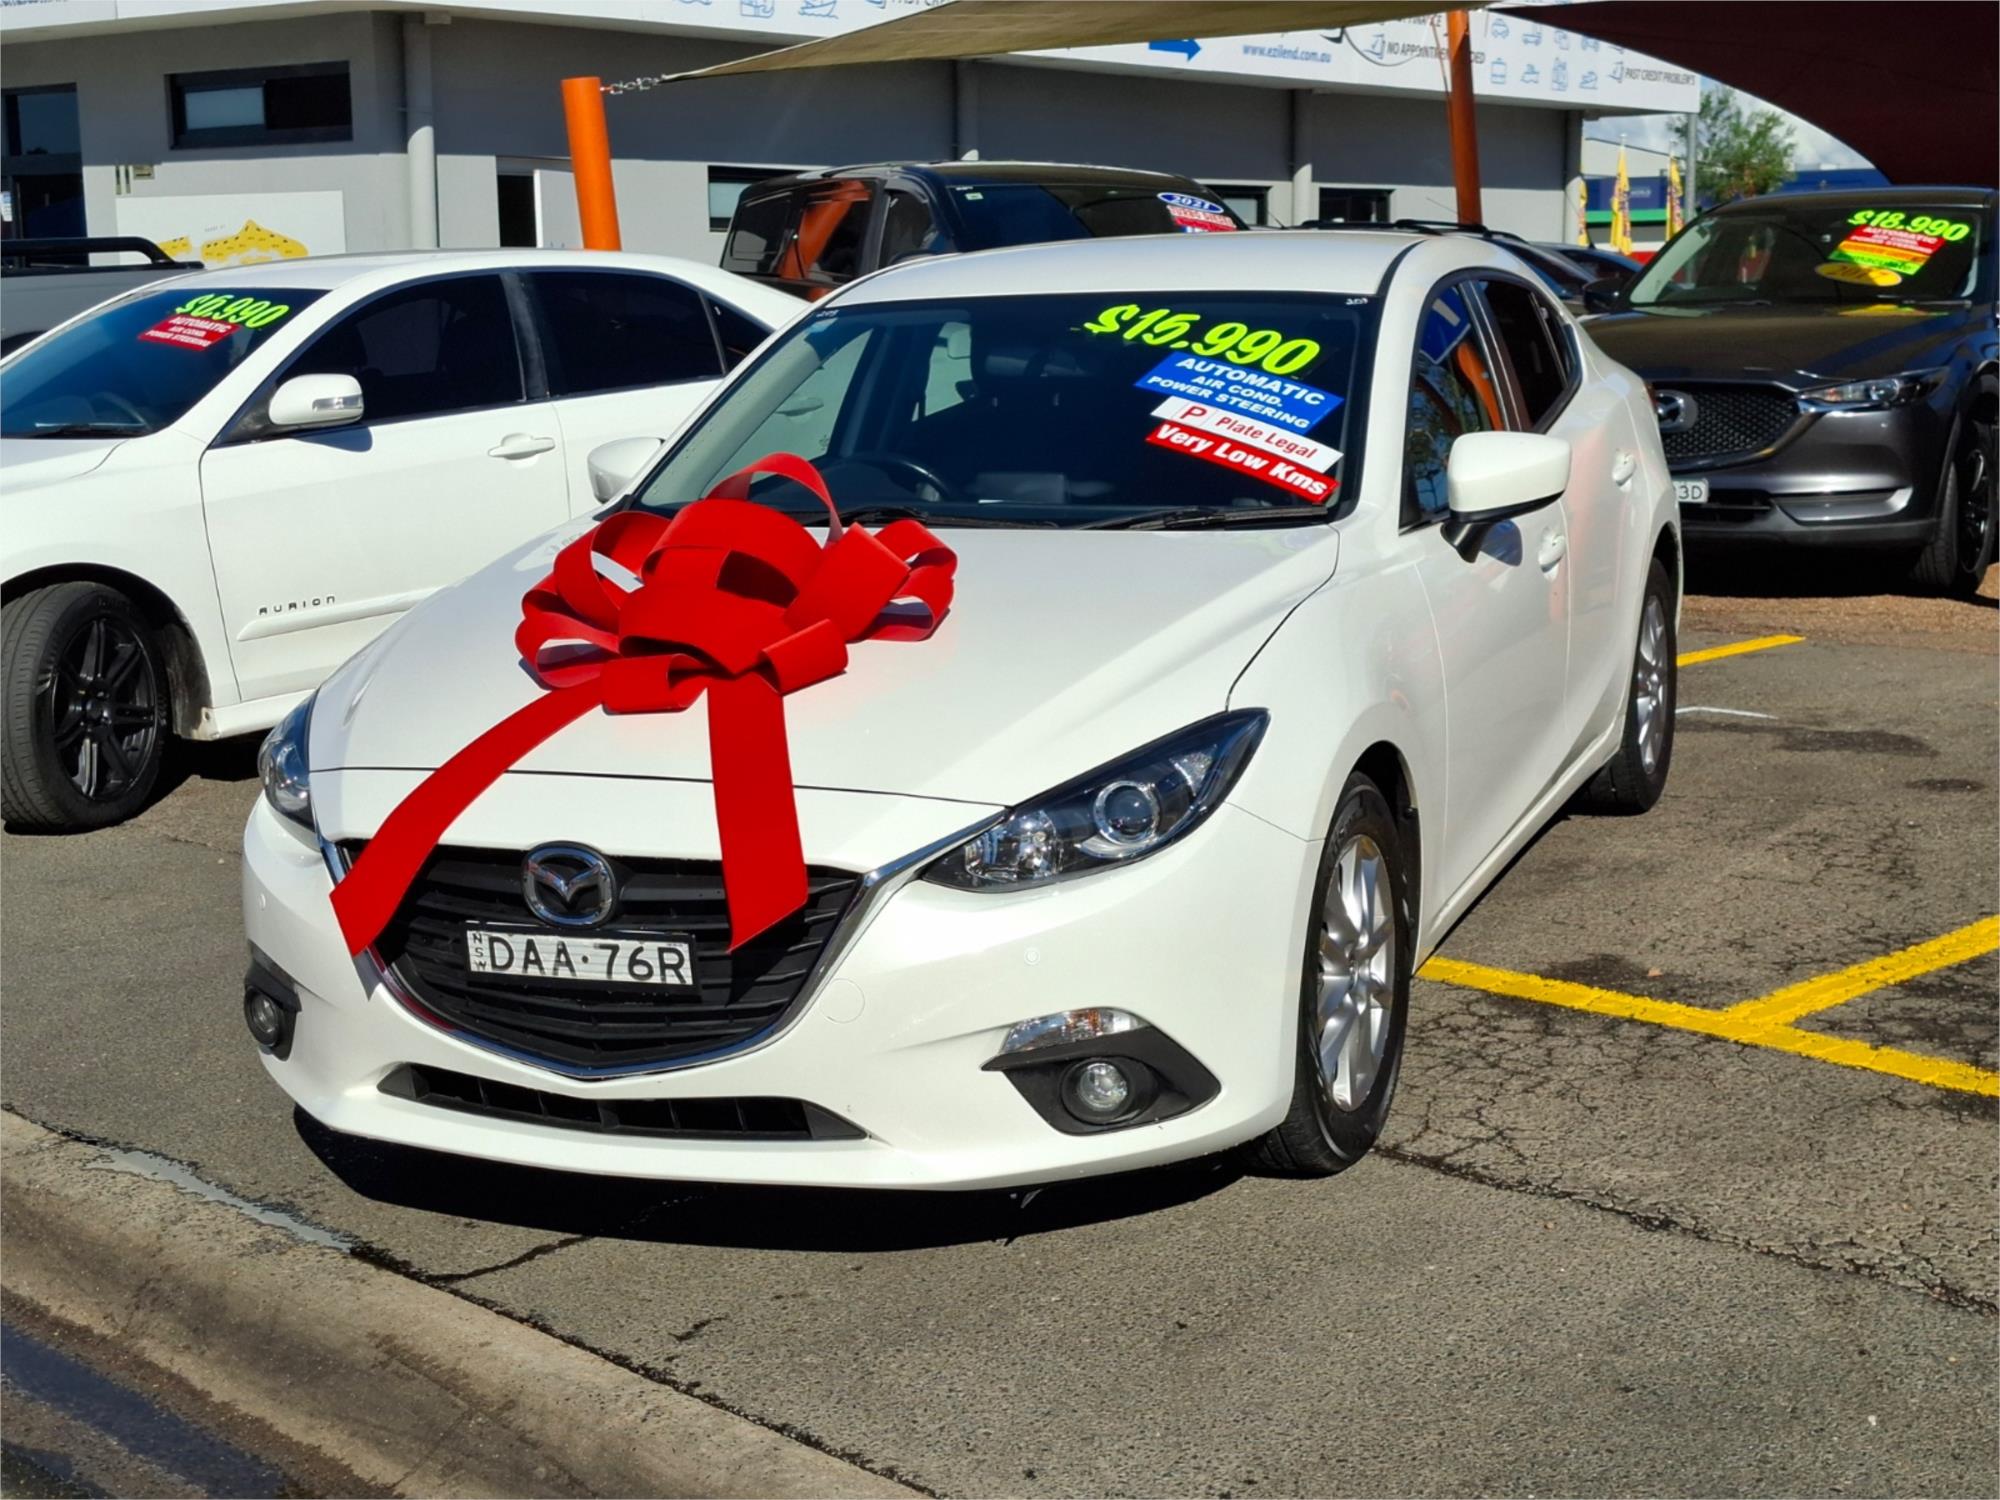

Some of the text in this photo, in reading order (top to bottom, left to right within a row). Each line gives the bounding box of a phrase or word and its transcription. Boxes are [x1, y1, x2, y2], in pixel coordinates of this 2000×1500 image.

[1243, 45, 1332, 63] www.ezilend.com.au
[1387, 42, 1398, 55] NO
[1176, 357, 1326, 405] AUTOMATIC
[1191, 375, 1283, 408] AIR COND.
[1147, 375, 1310, 430] POWER STEERING
[1179, 405, 1318, 460] P Plate Legal
[1156, 424, 1328, 496] Very Low Kms
[1673, 485, 1703, 500] 3D
